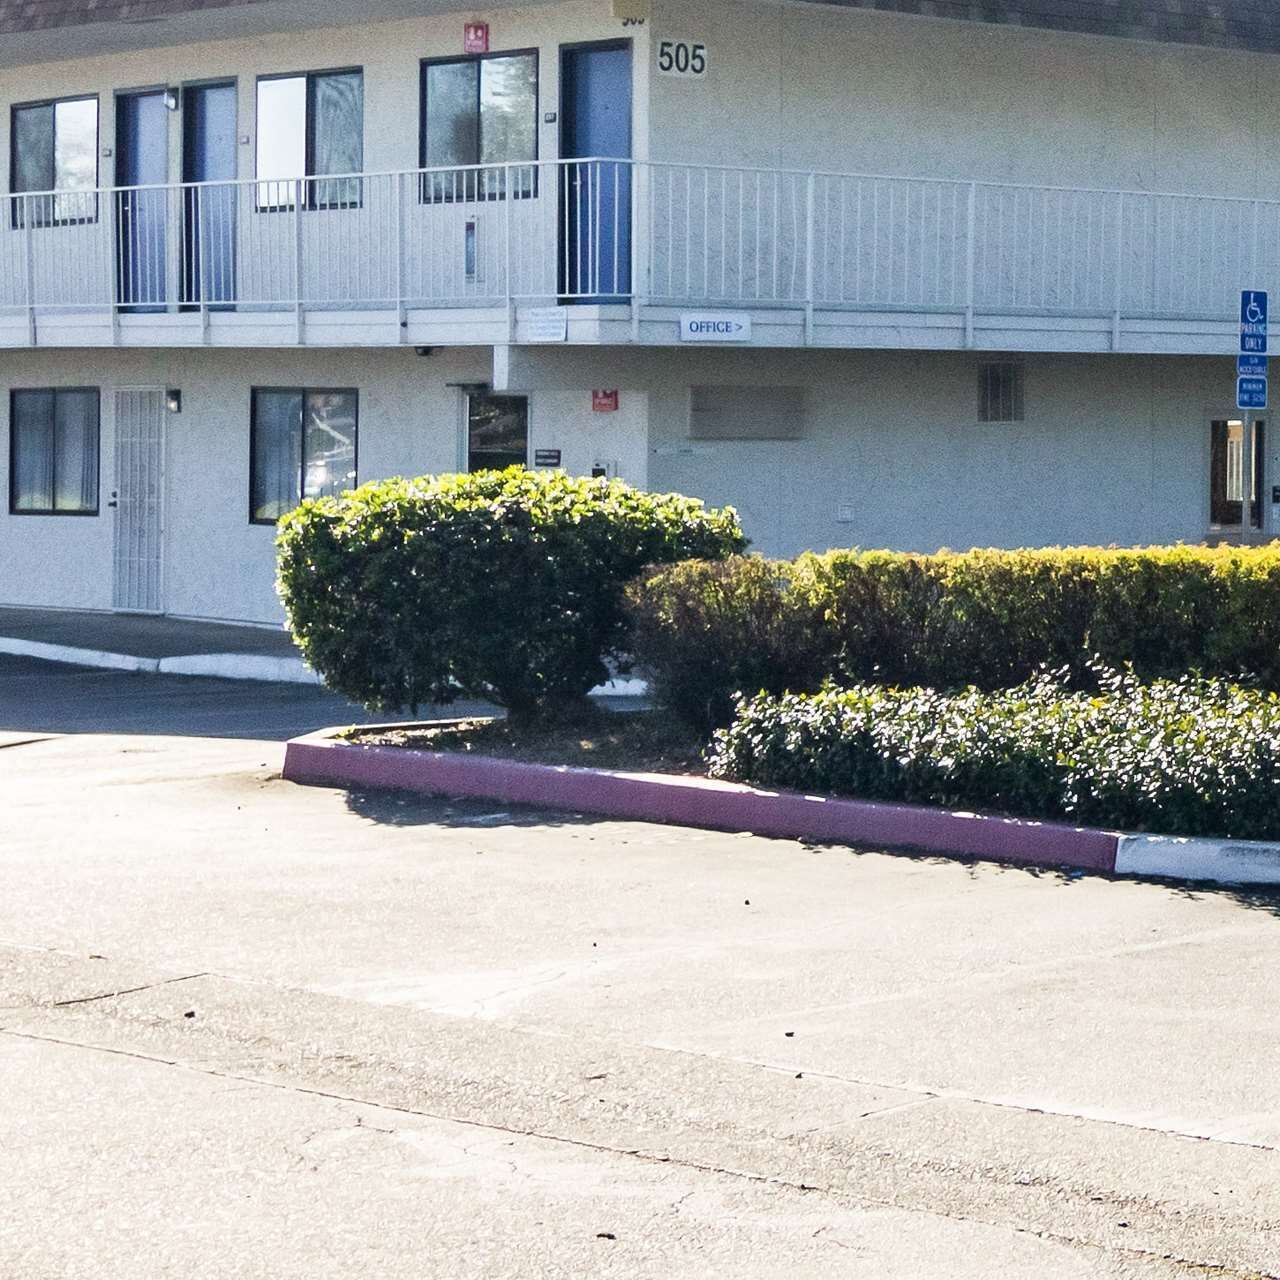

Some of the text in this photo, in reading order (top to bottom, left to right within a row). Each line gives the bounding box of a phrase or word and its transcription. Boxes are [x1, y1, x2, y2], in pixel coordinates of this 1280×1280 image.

[659, 41, 705, 74] 505
[689, 320, 732, 333] OFFICE
[1240, 322, 1266, 335] PARKING
[1245, 337, 1263, 350] ONLY
